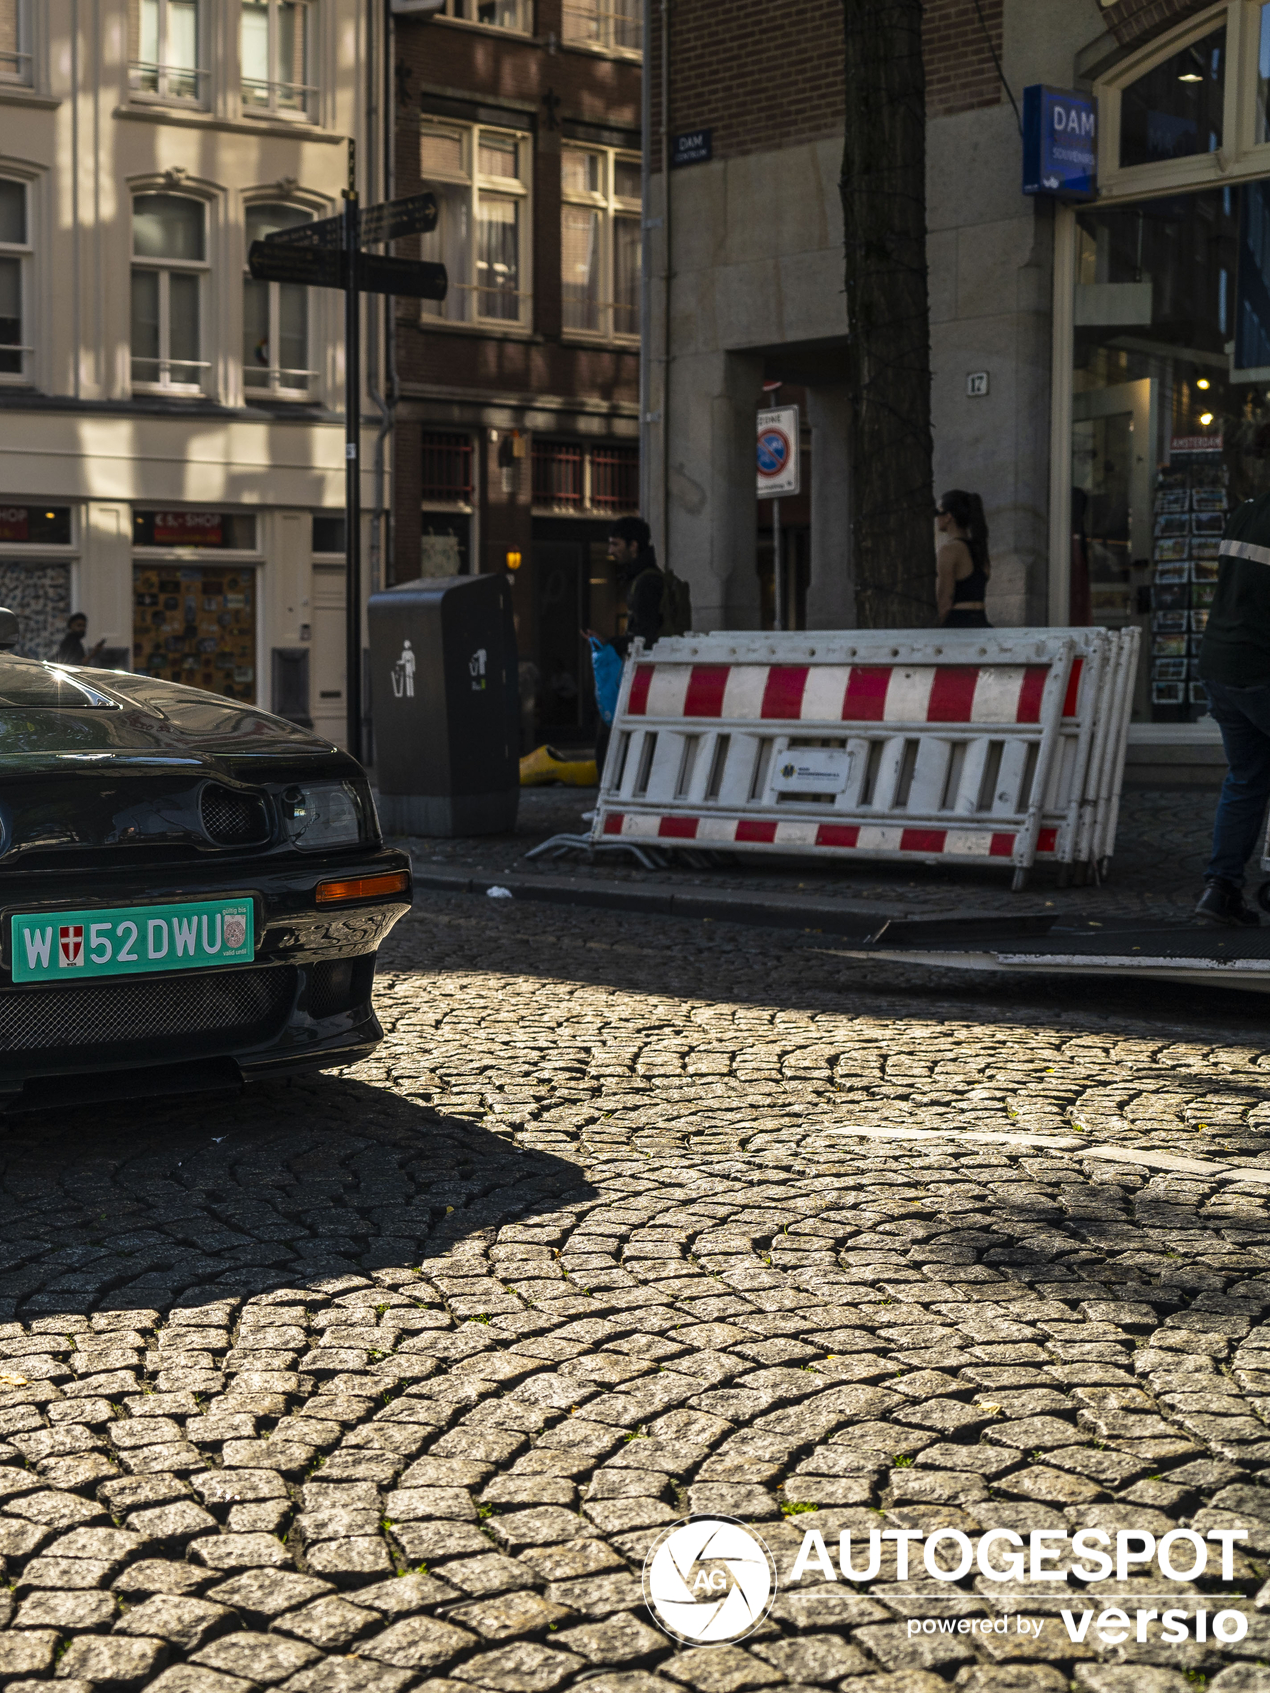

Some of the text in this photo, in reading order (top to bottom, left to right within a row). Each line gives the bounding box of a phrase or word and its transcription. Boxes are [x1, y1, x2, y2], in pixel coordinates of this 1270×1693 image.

[1053, 105, 1095, 138] DAM
[678, 133, 704, 151] DAM
[971, 375, 985, 393] 17
[1171, 436, 1221, 448] AMSTERDAM
[186, 513, 222, 527] SHOP
[23, 926, 53, 970] W
